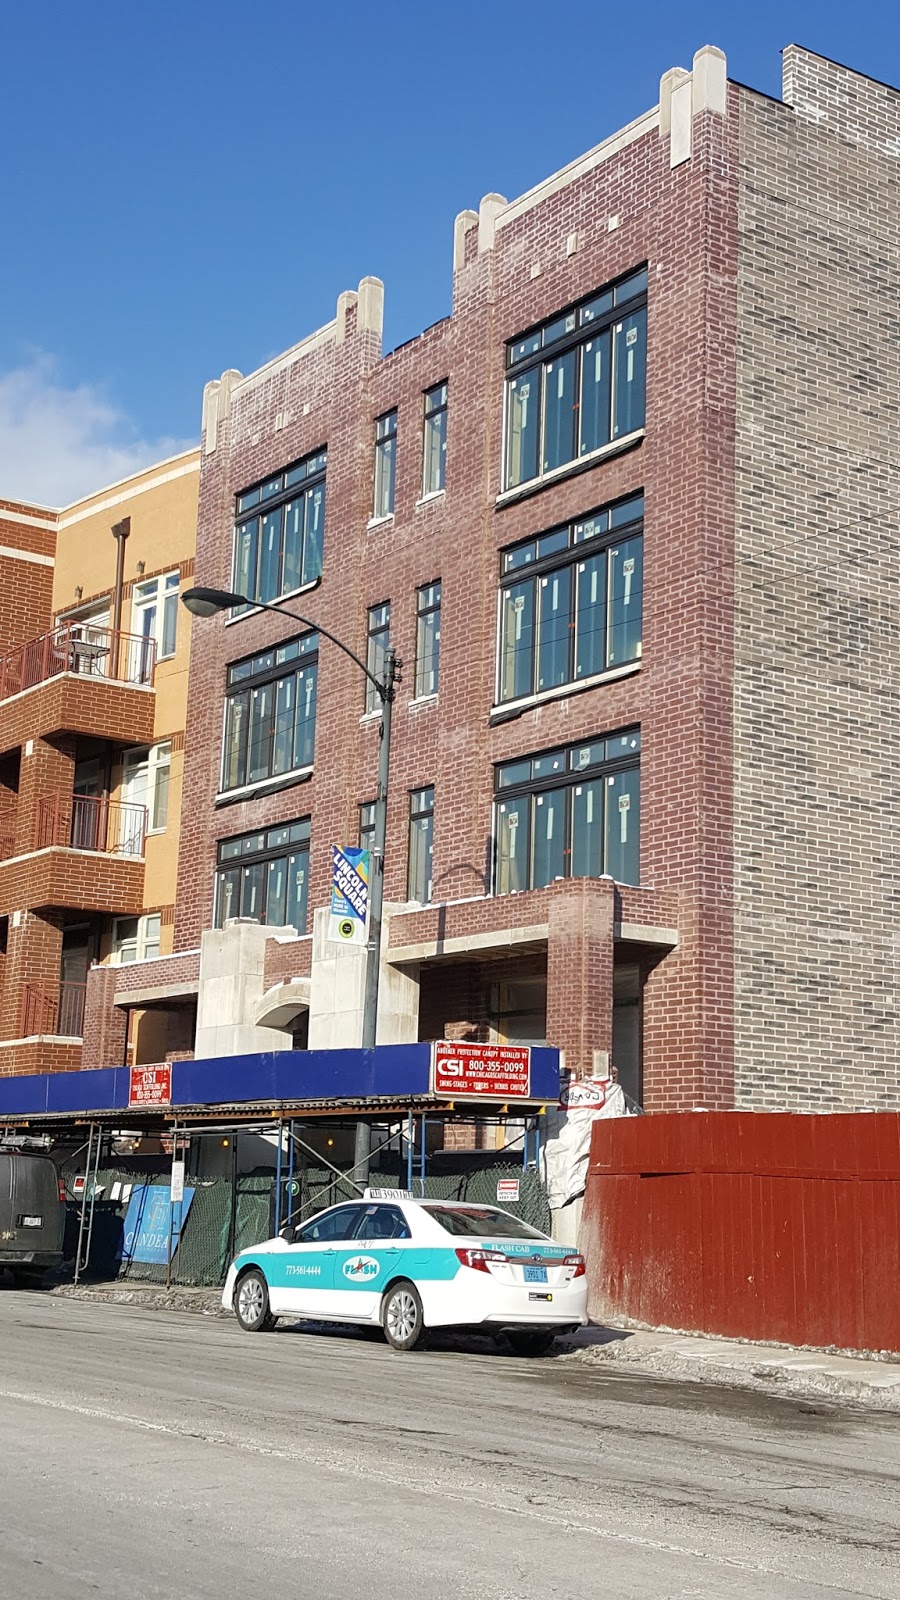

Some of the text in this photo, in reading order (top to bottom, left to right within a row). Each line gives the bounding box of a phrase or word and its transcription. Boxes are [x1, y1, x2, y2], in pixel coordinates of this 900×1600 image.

[333, 853, 367, 901] LINCOLN
[333, 871, 366, 916] SQUARE
[457, 1048, 481, 1057] PROTECTION
[437, 1059, 524, 1076] CSI 800-355-0099
[142, 1072, 156, 1083] CSI
[382, 1190, 403, 1199] 3901
[491, 1244, 530, 1253] FLASH CAB
[286, 1265, 320, 1275] 773-561-4444
[345, 1257, 377, 1275] FLASH
